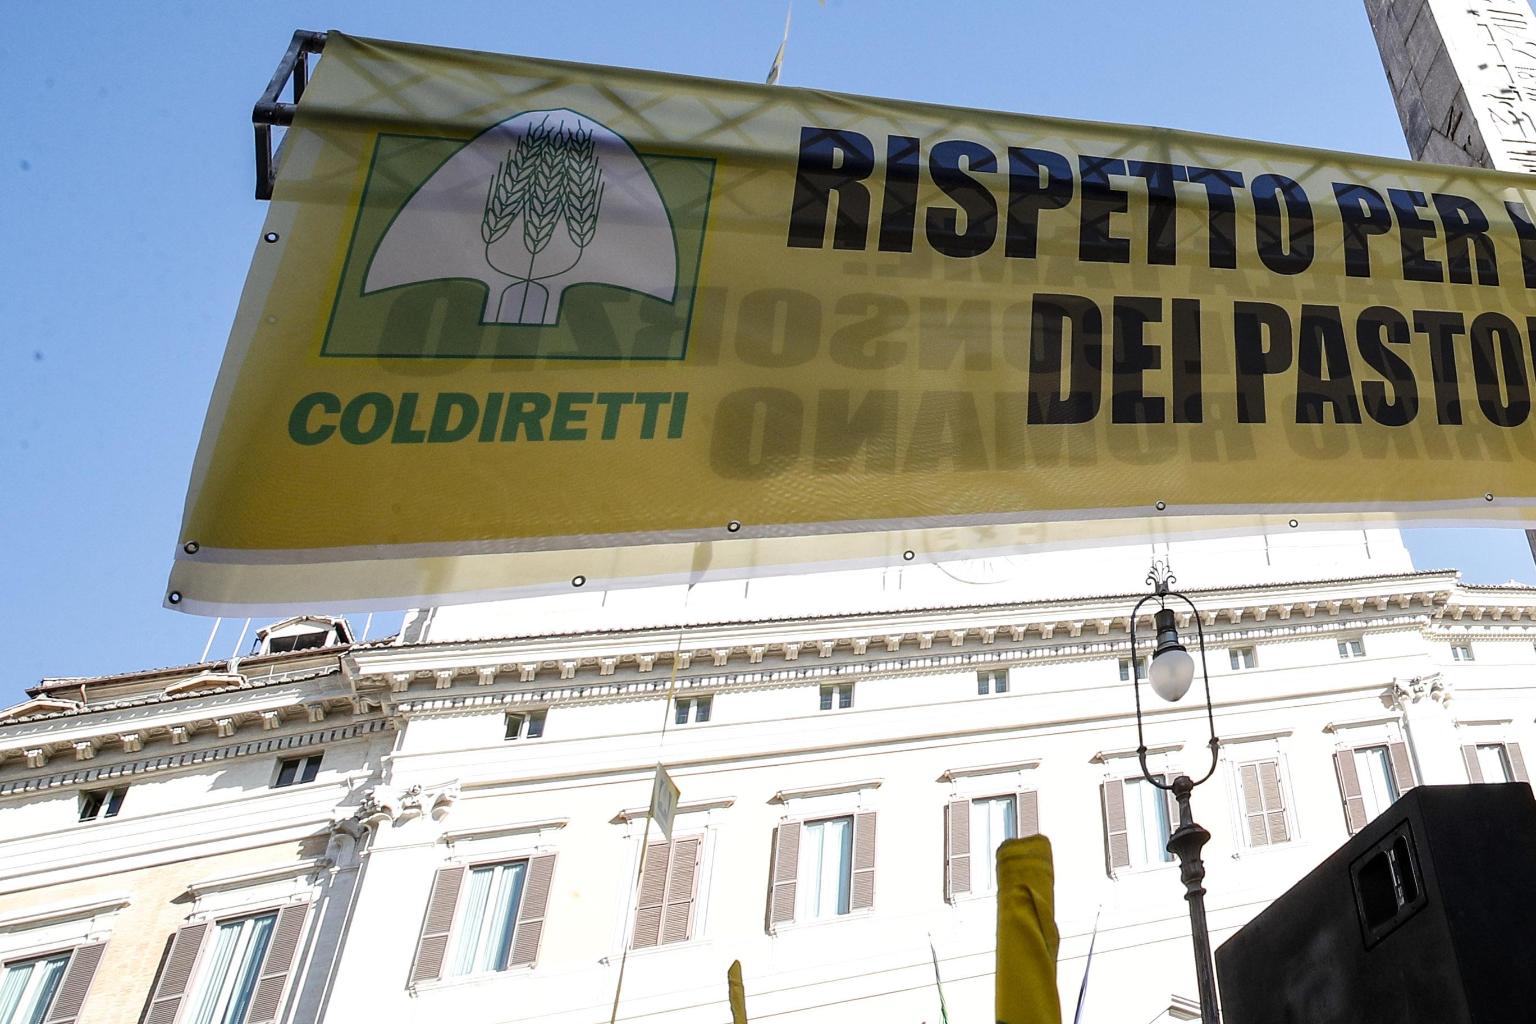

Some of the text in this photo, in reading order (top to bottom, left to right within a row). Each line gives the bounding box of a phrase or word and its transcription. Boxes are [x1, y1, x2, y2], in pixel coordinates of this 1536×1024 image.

[787, 127, 1315, 275] RISPETTO
[1332, 182, 1499, 287] PER
[287, 391, 689, 446] COLDIRETTI
[1028, 294, 1202, 425] DEI
